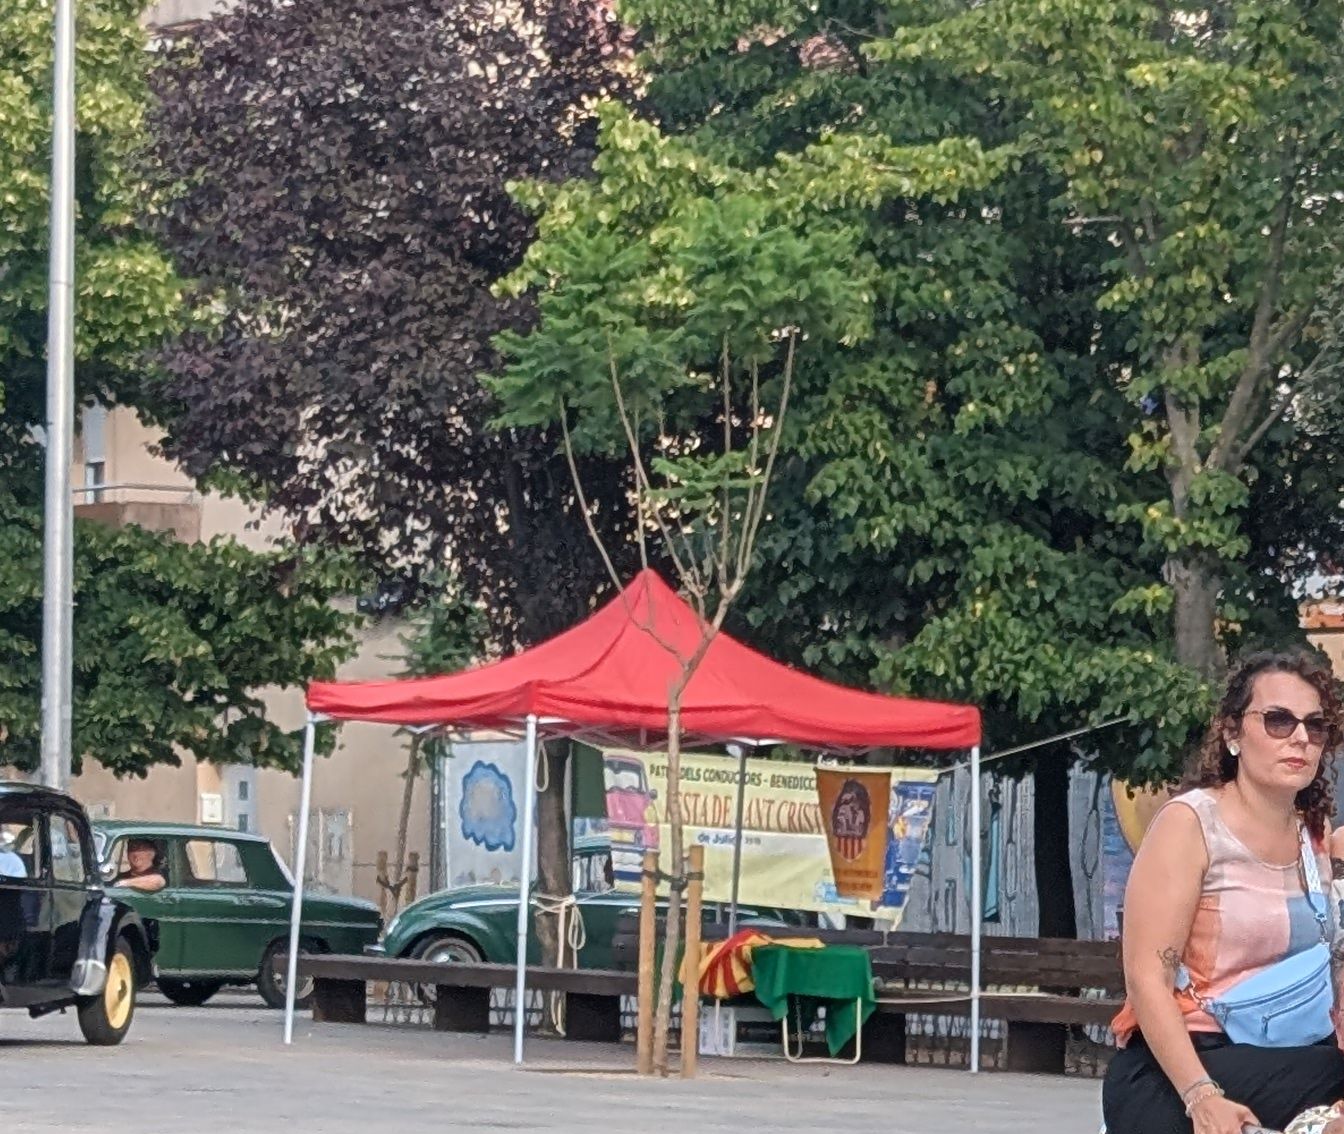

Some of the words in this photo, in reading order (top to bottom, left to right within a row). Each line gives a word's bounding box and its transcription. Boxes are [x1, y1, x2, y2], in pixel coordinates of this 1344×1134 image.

[703, 768, 761, 786] CONDUCORS
[770, 774, 816, 791] BENEDICC
[777, 800, 822, 834] CRIST
